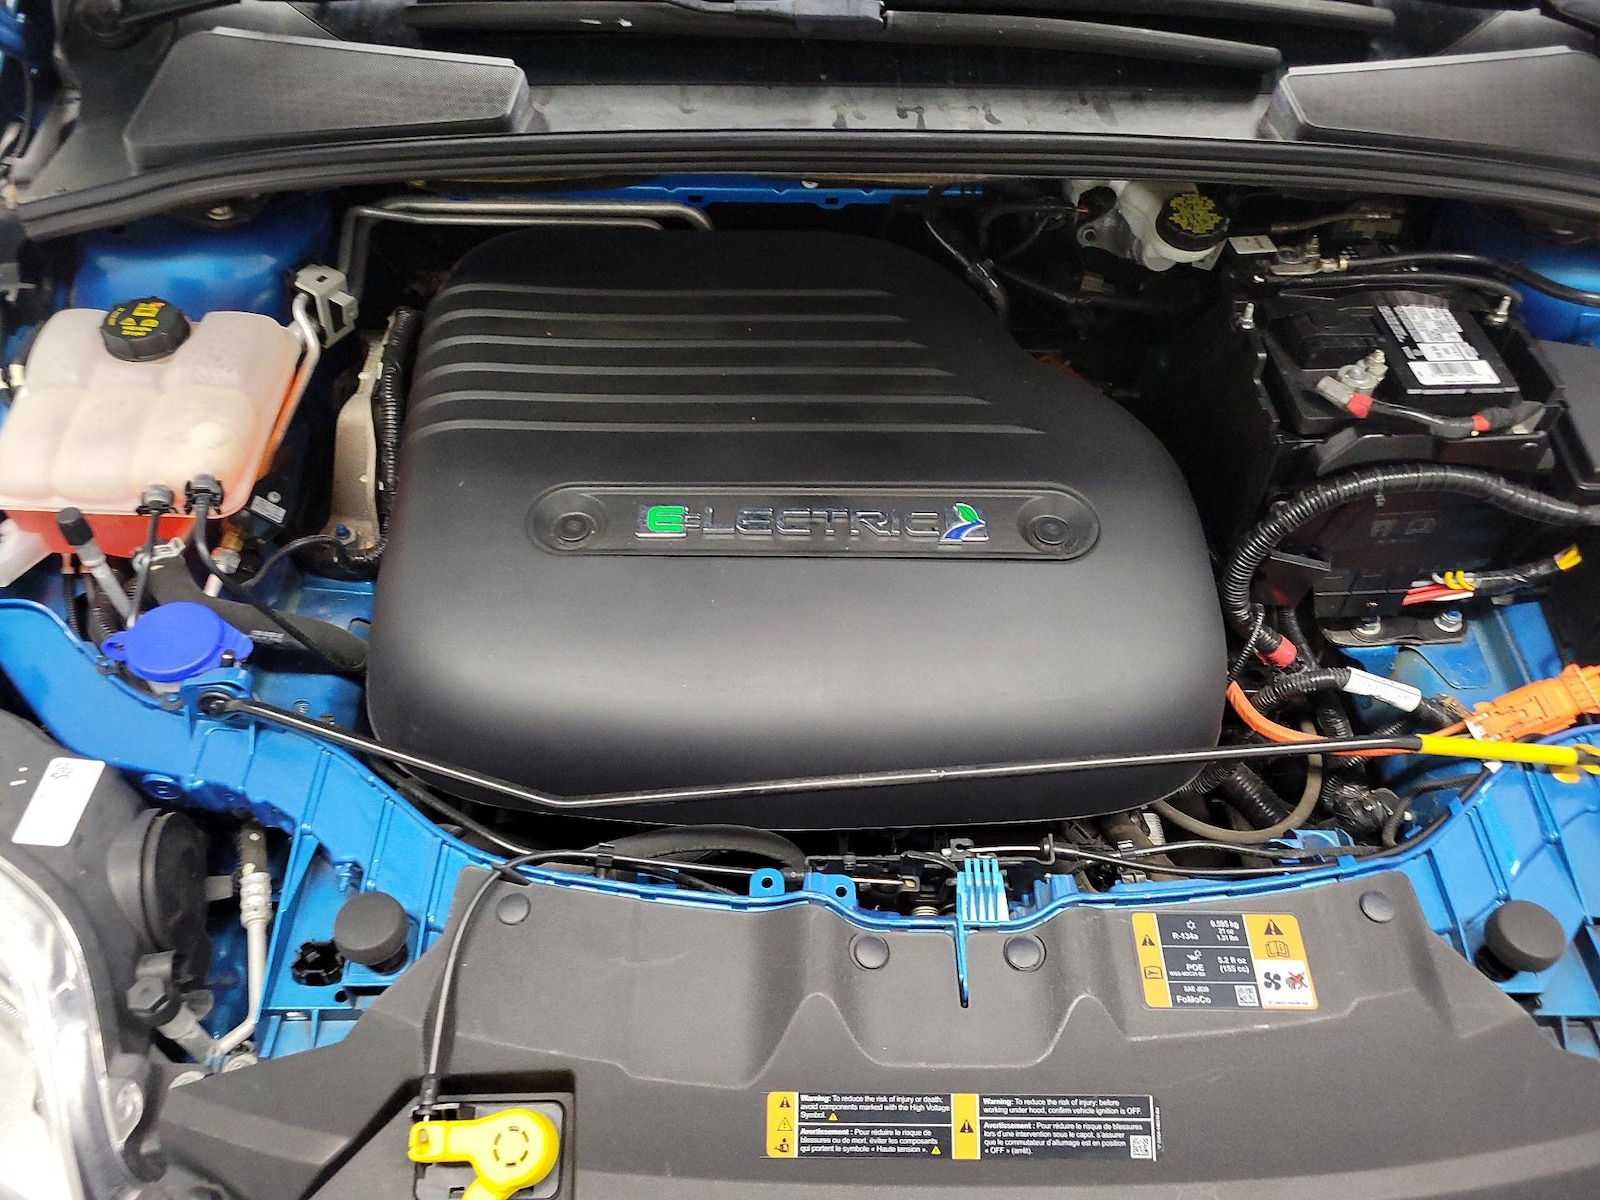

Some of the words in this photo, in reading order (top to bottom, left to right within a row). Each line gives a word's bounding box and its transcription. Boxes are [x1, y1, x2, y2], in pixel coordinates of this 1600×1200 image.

[1171, 932, 1199, 940] R-134a
[1185, 963, 1205, 971] POE
[1220, 965, 1236, 973] (155
[1237, 965, 1250, 974] cc)
[1176, 995, 1212, 1004] FoMoCo
[800, 1094, 832, 1103] Warning:
[896, 1096, 914, 1104] injury
[982, 1098, 1014, 1107] Warning:
[1099, 1099, 1120, 1107] before
[910, 1104, 925, 1112] High
[926, 1103, 950, 1112] Voltage
[983, 1106, 1008, 1115] working
[1073, 1107, 1095, 1115] vehicle
[1096, 1107, 1119, 1115] ignition
[1126, 1107, 1142, 1115] OFF.
[800, 1111, 827, 1119] Symbol.
[1052, 1122, 1075, 1130] réduire
[1083, 1123, 1102, 1131] risque
[1112, 1123, 1143, 1131] blessures
[902, 1129, 922, 1137] risque
[800, 1136, 831, 1144] blessures
[899, 1138, 938, 1146] composants
[1101, 1140, 1127, 1148] position
[800, 1145, 810, 1153] qui
[811, 1145, 834, 1153] portent
[842, 1145, 870, 1153] symbole
[876, 1145, 896, 1153] Haute
[896, 1145, 920, 1153] tension
[990, 1146, 1005, 1154] OFF
